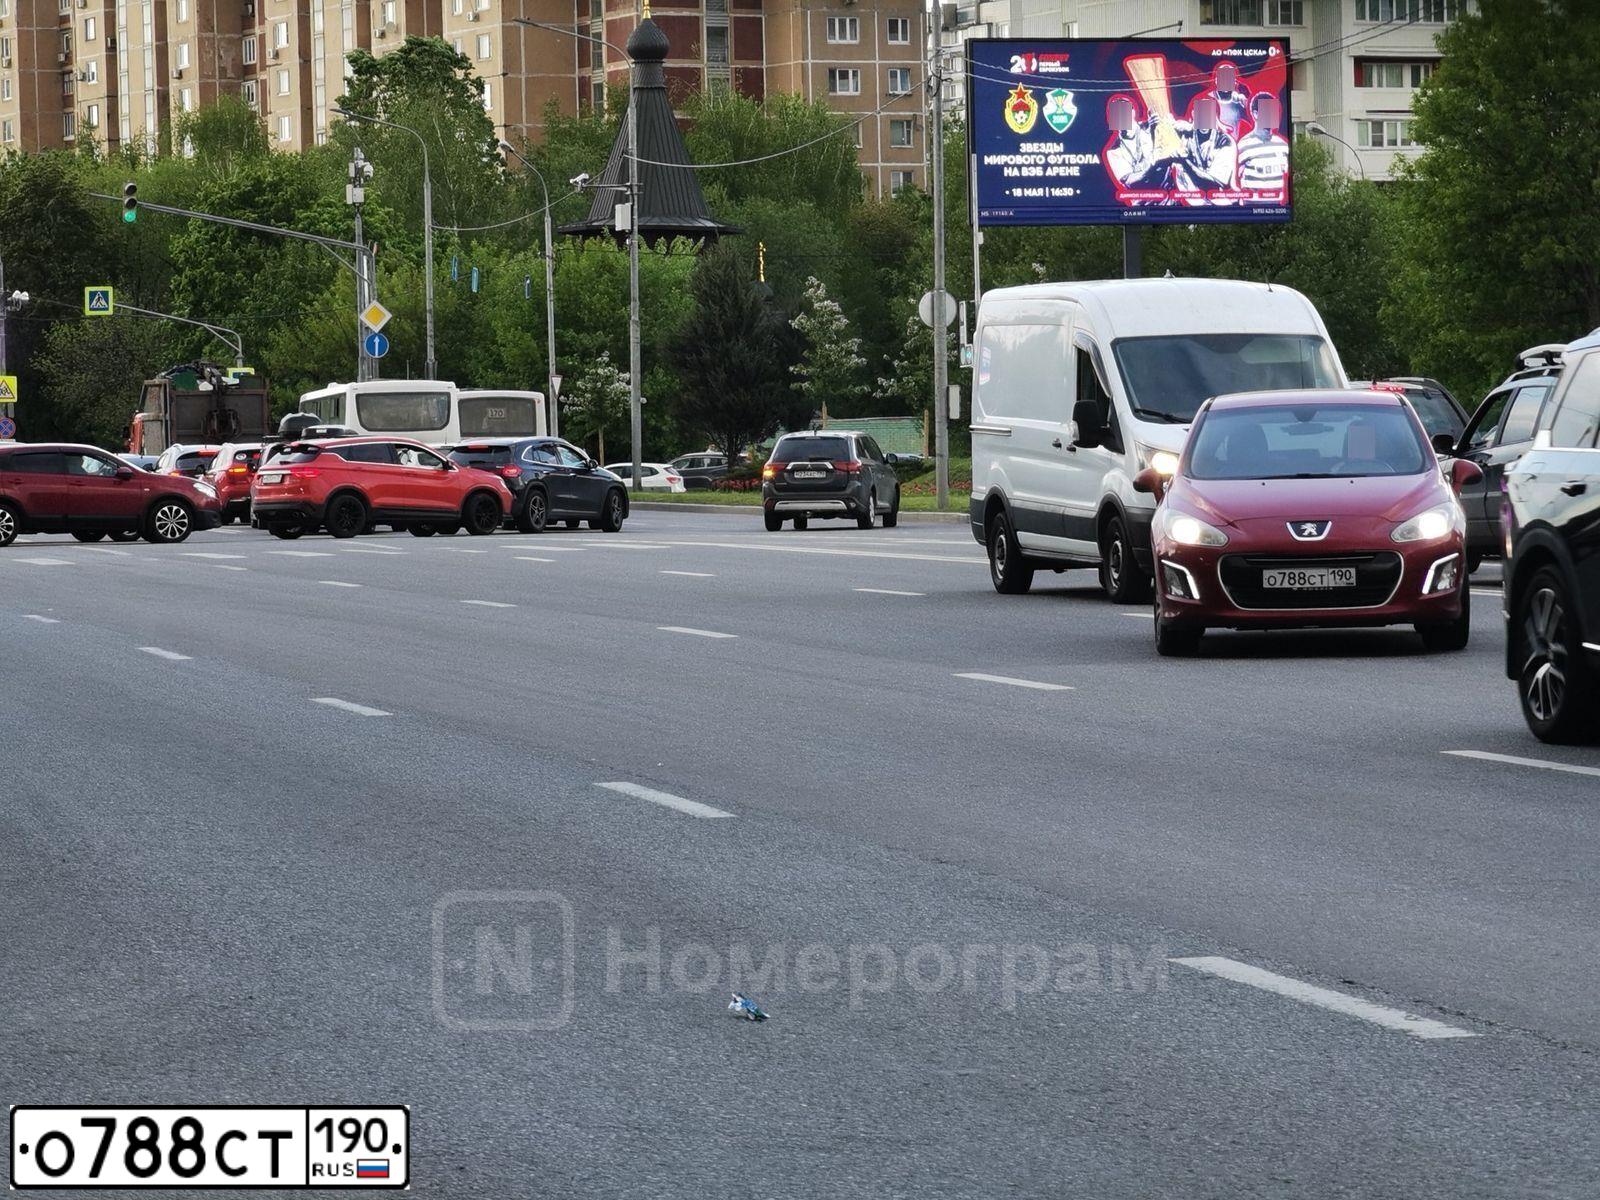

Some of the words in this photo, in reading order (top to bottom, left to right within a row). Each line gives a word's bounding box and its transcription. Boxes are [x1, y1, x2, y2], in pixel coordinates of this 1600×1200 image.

[1019, 143, 1064, 154] ЗВЕЗДЫ
[984, 155, 1046, 165] МИРОВОГО
[1047, 154, 1100, 164] ФУТБОЛА
[1004, 167, 1020, 176] НА
[1021, 167, 1043, 176] ВЭБ
[1045, 166, 1080, 176] АРЕНЕ
[1012, 188, 1022, 197] 18
[1024, 188, 1043, 197] МАЯ
[1050, 188, 1073, 196] 16:30
[1267, 572, 1326, 587] О788СТ
[1329, 569, 1352, 582] 190
